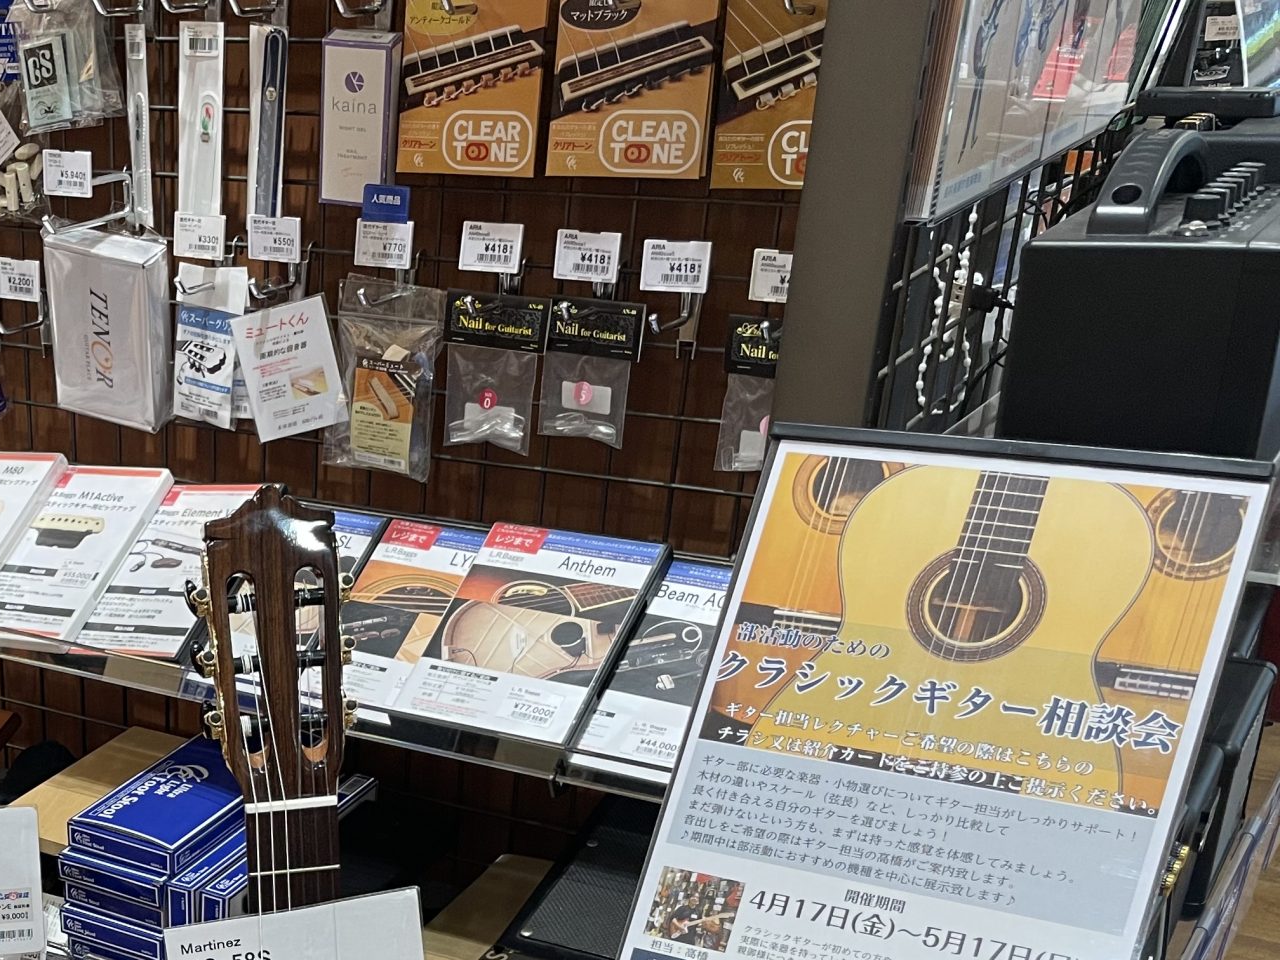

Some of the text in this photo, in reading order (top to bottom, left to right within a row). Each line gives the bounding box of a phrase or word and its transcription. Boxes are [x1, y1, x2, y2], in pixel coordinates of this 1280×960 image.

[570, 9, 629, 22] マットブラック
[332, 96, 377, 114] kaina
[453, 119, 520, 141] CLEAR
[611, 120, 687, 142] CLEAR
[401, 139, 437, 149] クリアトーン
[552, 141, 593, 151] クリアトーン
[370, 194, 401, 205] 人気商品
[273, 237, 292, 247] ¥550
[564, 233, 578, 241] ARIA
[382, 242, 403, 253] ¥770
[484, 242, 508, 254] ¥418
[580, 252, 606, 265] ¥418
[669, 262, 697, 274] ¥418
[245, 311, 310, 340] ミュートくん
[458, 315, 532, 336] Nail for Guitarist
[555, 320, 627, 342] Nail for Guitarist
[89, 287, 114, 390] TENOR
[739, 343, 766, 359] Nail
[2, 465, 24, 475] M80
[77, 490, 125, 502] M1Active
[180, 507, 222, 519] Element
[391, 530, 426, 543] レジまで
[494, 534, 531, 548] レジまで
[557, 555, 617, 579] Anthem
[657, 583, 700, 605] Beam
[735, 620, 892, 661] 部活動のための
[715, 650, 1183, 754] クラシックギター相談会
[725, 702, 1095, 777] ギター担当レクチャーご希望の際はこちらの
[718, 725, 1157, 815] チラシ又は紹介カードをご持参の上ご提示ください。
[97, 795, 140, 820] Stool
[844, 888, 907, 915] 開催期間
[1, 912, 25, 921] ¥9,000
[180, 937, 242, 956] Martinez
